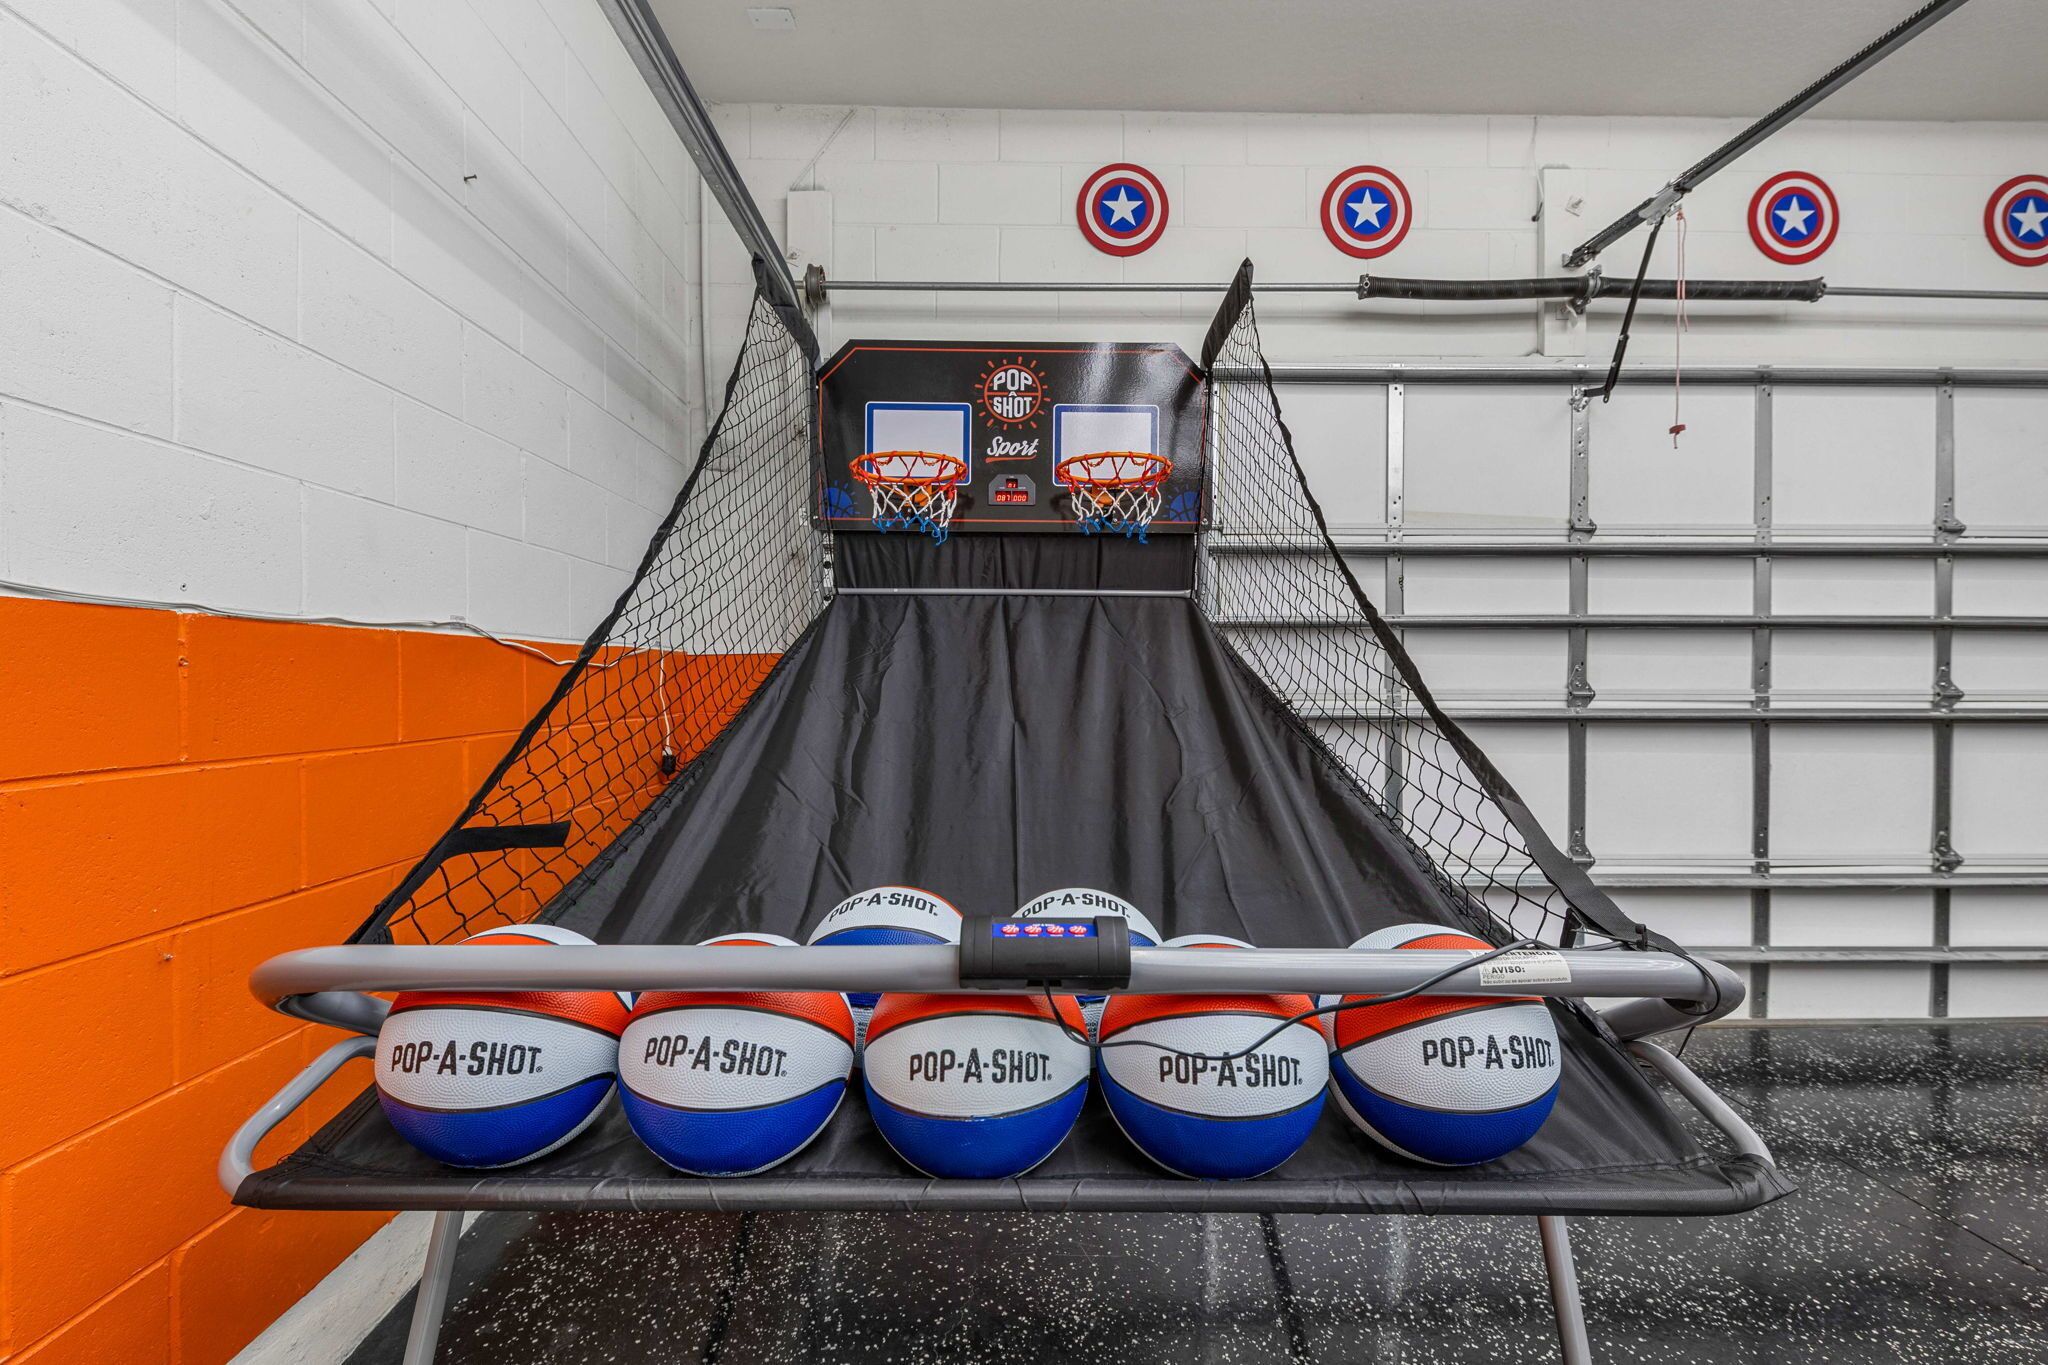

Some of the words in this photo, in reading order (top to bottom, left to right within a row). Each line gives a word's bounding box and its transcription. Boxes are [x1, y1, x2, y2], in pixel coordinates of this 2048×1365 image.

[993, 369, 1033, 391] POP
[993, 396, 1033, 418] SHOT
[987, 436, 1039, 457] Sport
[828, 892, 938, 922] POP-A-SHOT
[1491, 966, 1526, 974] AVISO:
[391, 1040, 543, 1076] POP-A-SHOT
[644, 1034, 787, 1077] POP-A-SHOT
[909, 1048, 1051, 1083] POP-A-SHOT
[1422, 1034, 1553, 1069] POP-A-SHOT
[1159, 1052, 1302, 1087] POP-A-SHOT
